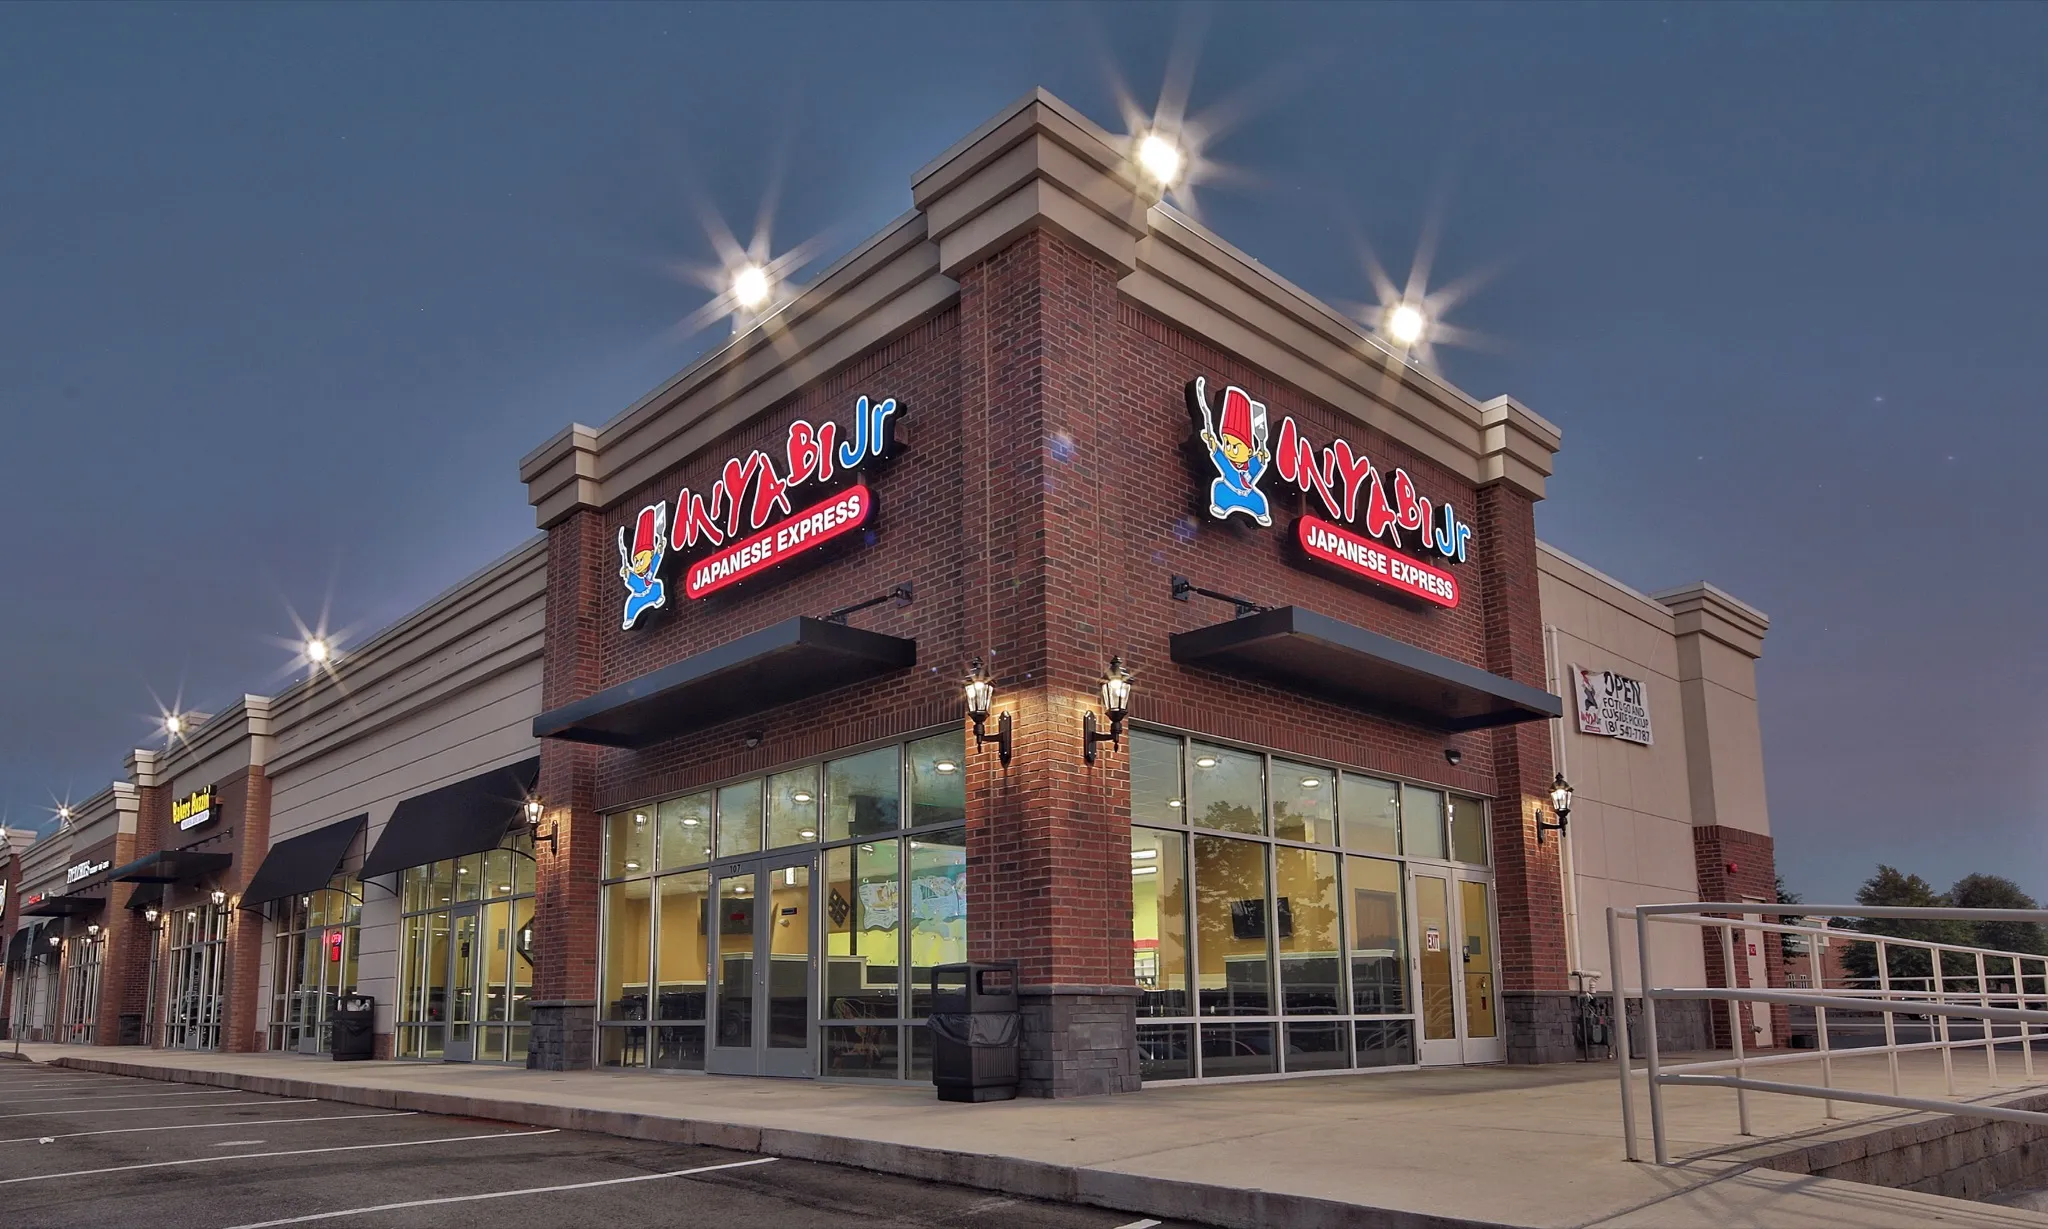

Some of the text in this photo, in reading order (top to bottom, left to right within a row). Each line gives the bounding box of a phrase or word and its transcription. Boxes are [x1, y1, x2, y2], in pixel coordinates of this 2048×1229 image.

[671, 395, 896, 551] MIYABI Jr
[1276, 416, 1471, 562] MIYABI Jr
[692, 495, 861, 591] JAPANESE EXPRESS
[1306, 525, 1453, 600] JAPANESE EXPRESS
[1604, 671, 1641, 706] OPEN
[1632, 705, 1645, 718] AND
[730, 864, 741, 874] 107
[1427, 933, 1439, 950] EXIT
